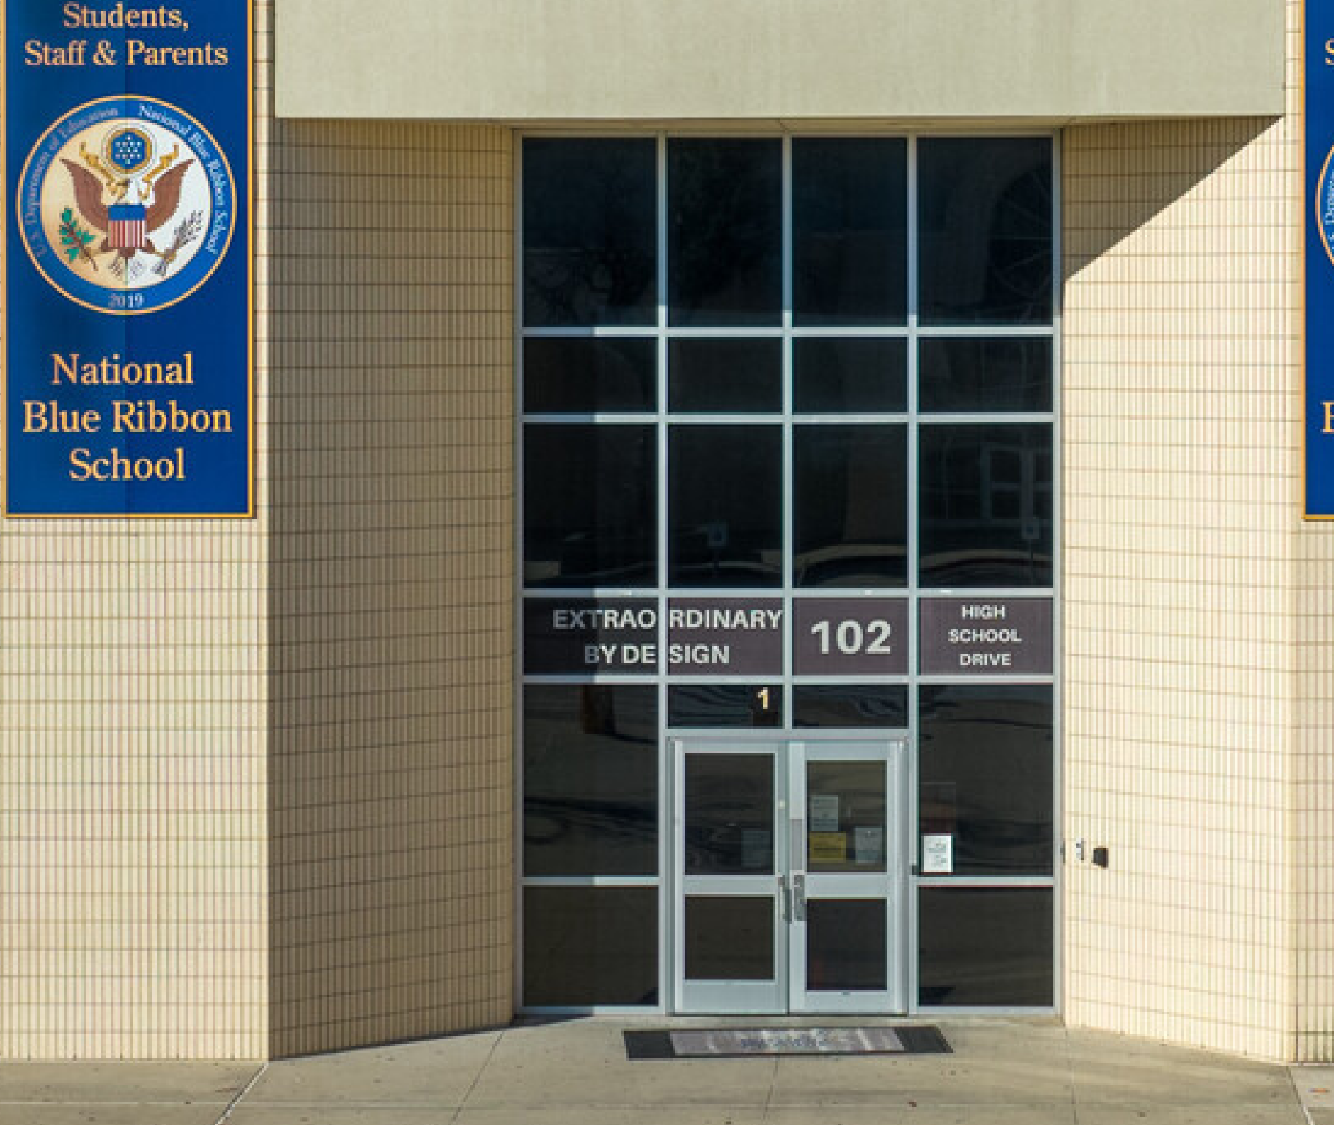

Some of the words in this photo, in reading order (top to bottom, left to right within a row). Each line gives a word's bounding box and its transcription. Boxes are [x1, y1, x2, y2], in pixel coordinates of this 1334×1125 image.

[63, 1, 189, 31] Students,
[24, 39, 87, 65] Staff
[92, 39, 117, 65] &
[127, 39, 229, 65] Parents
[108, 293, 144, 309] 2019
[50, 351, 194, 386] National
[22, 400, 102, 433] Blue
[112, 400, 233, 433] Ribbon
[69, 448, 186, 482] School
[961, 604, 1006, 620] HIGH
[810, 620, 892, 655] 102
[947, 628, 1023, 643] SCHOOL
[584, 644, 618, 664] BY
[959, 652, 1012, 666] DRIVE
[756, 687, 770, 709] 1
